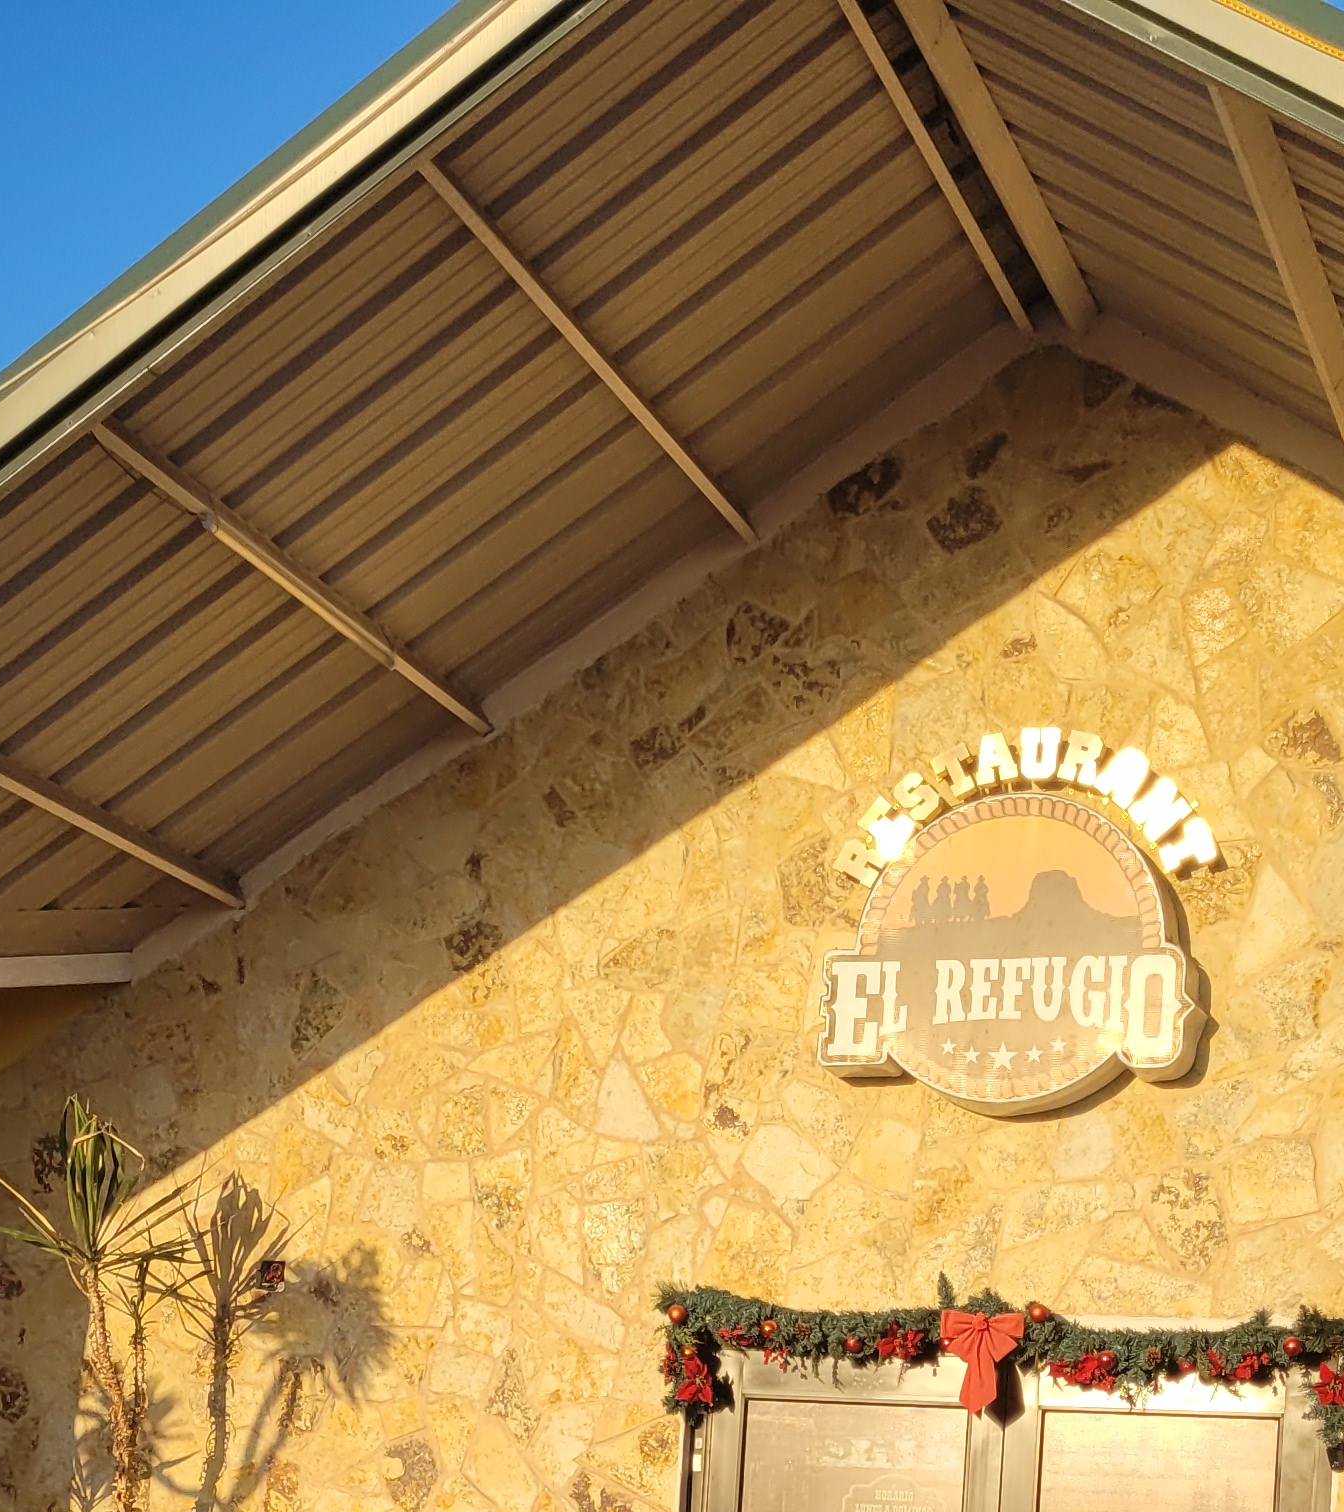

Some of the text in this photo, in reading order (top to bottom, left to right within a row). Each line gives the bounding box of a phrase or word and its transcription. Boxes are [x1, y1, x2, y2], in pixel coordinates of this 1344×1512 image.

[833, 726, 1217, 889] RESTAURANT
[827, 954, 1181, 1058] EL REFUGIO
[874, 1489, 914, 1502] HORARIO
